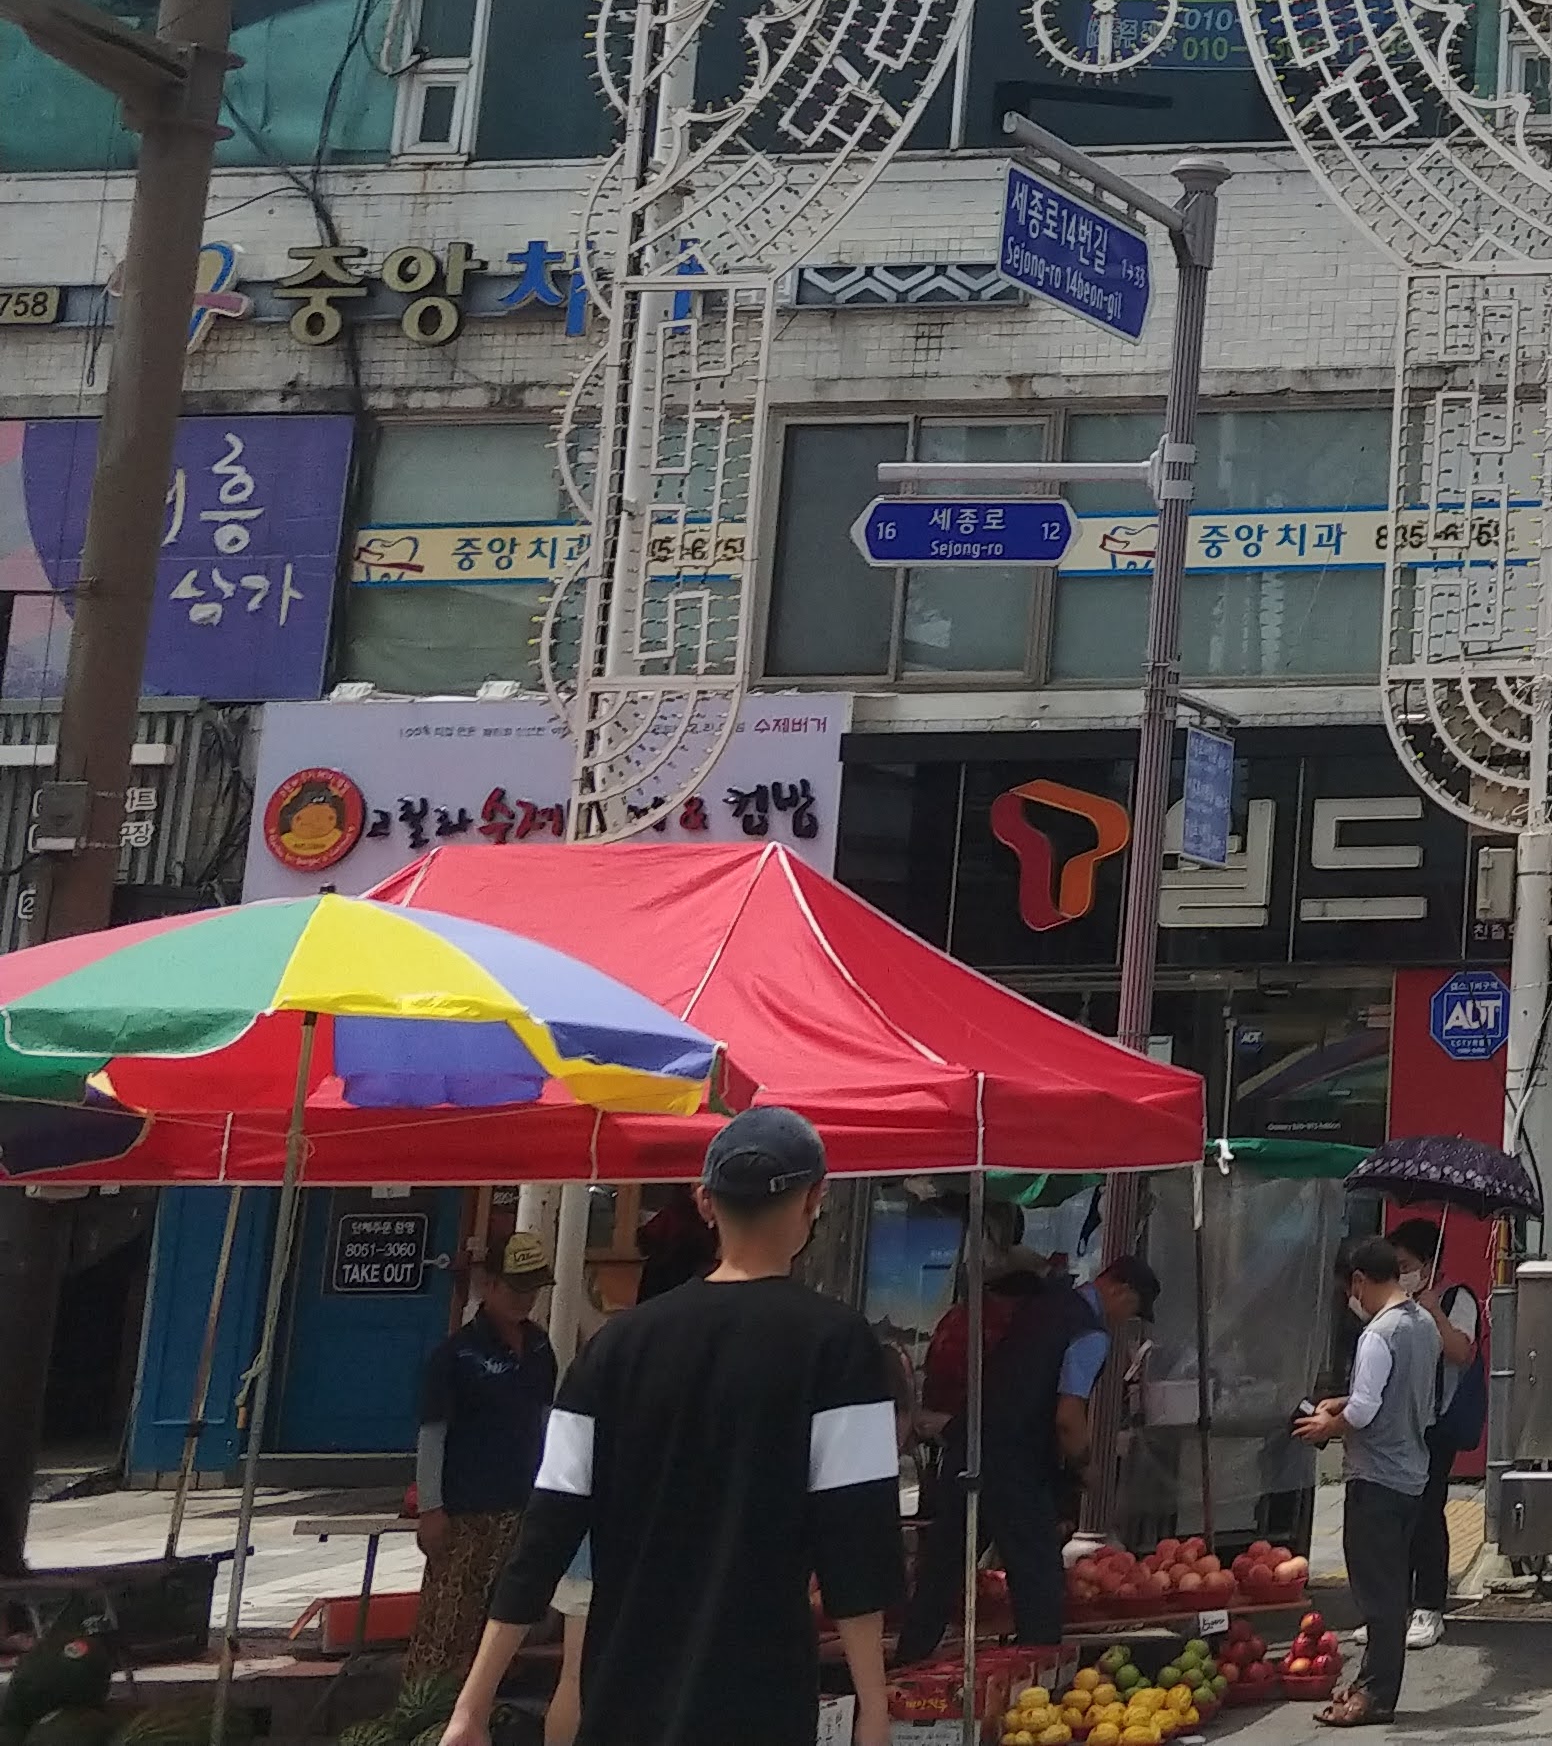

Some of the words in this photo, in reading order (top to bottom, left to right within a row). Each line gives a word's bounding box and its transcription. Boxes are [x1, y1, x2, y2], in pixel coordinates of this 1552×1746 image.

[1011, 181, 1110, 276] 세종로14번길
[1006, 236, 1061, 289] Sejong-ro
[1066, 267, 1122, 322] 14beon-gil
[928, 506, 1008, 532] 세종로
[875, 520, 897, 542] 16
[1041, 522, 1061, 542] 12
[1198, 522, 1344, 558] 중앙치과
[929, 538, 1004, 558] Sejong-ro
[754, 717, 828, 734] 수제버거
[1444, 1000, 1501, 1030] ADT
[344, 1242, 416, 1258] 8051-3060
[342, 1264, 380, 1284] TAKE
[383, 1263, 414, 1283] OUT
